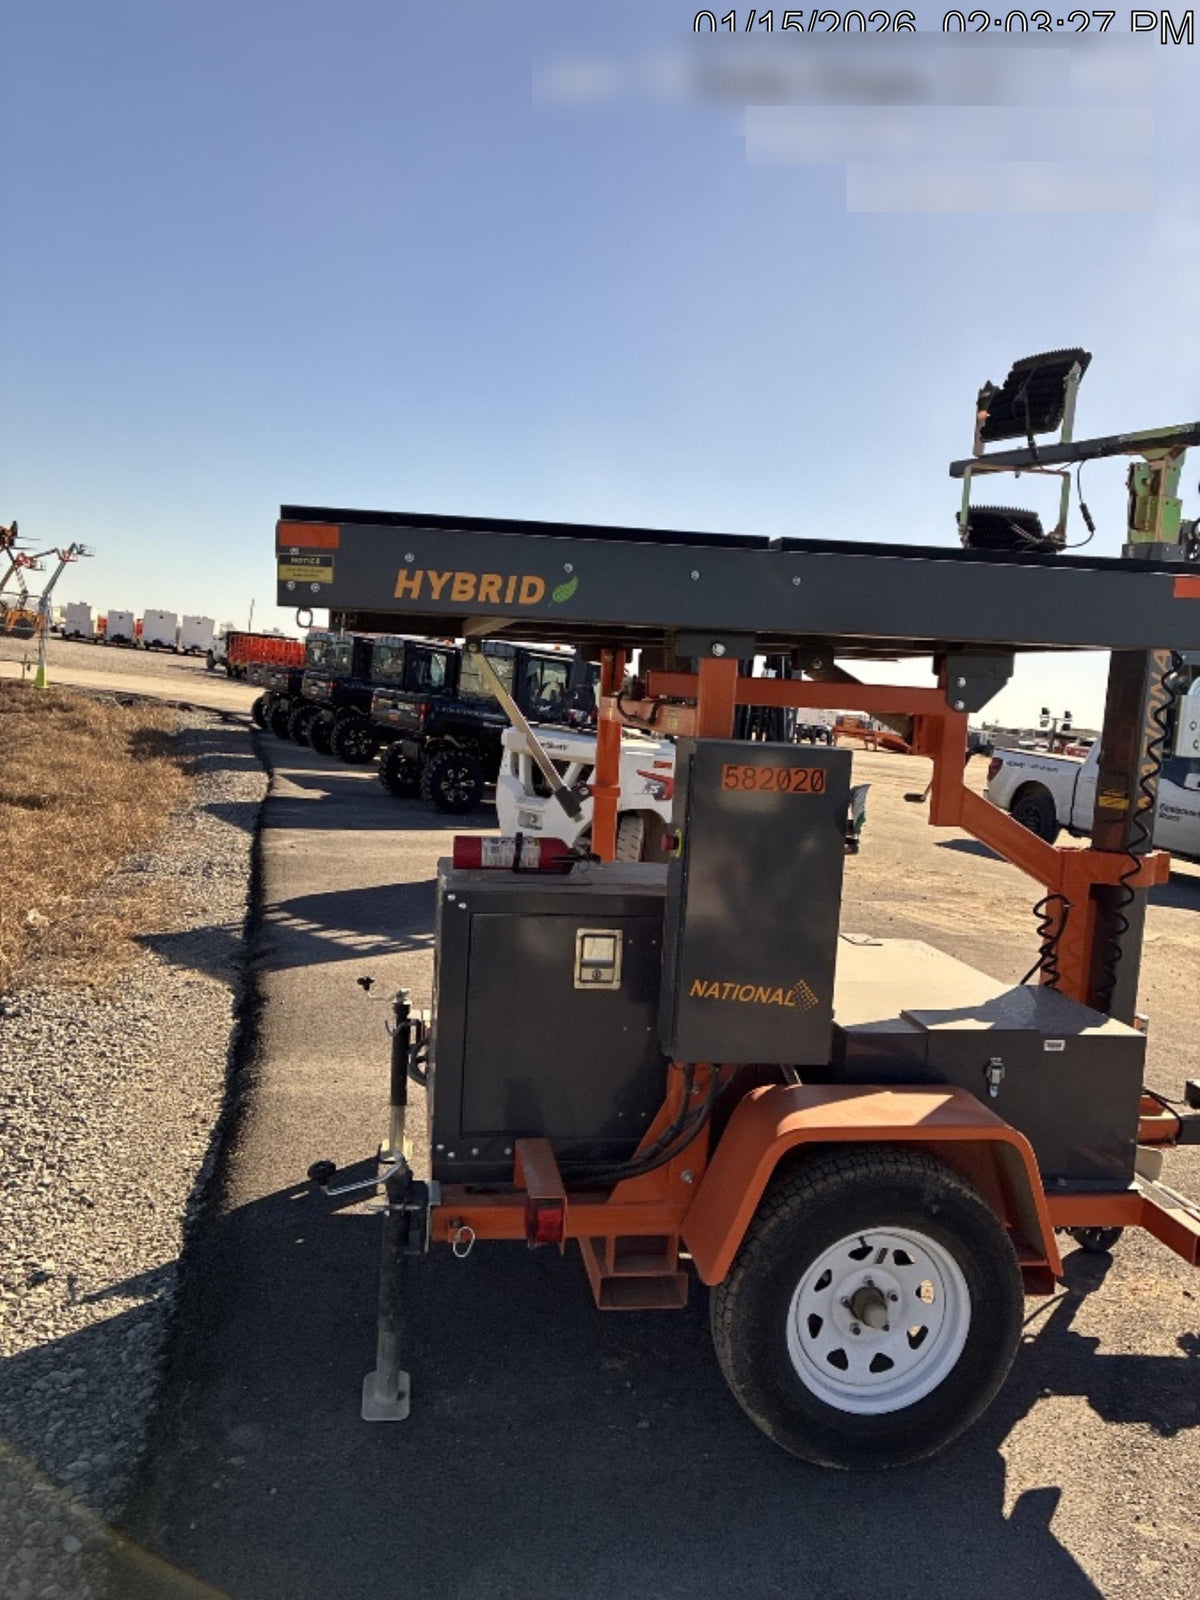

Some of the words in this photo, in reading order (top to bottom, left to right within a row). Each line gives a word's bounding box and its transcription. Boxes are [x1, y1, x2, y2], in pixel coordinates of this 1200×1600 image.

[394, 568, 546, 606] HYBRID
[724, 766, 825, 792] 582020
[689, 979, 796, 1007] NATIONAL
